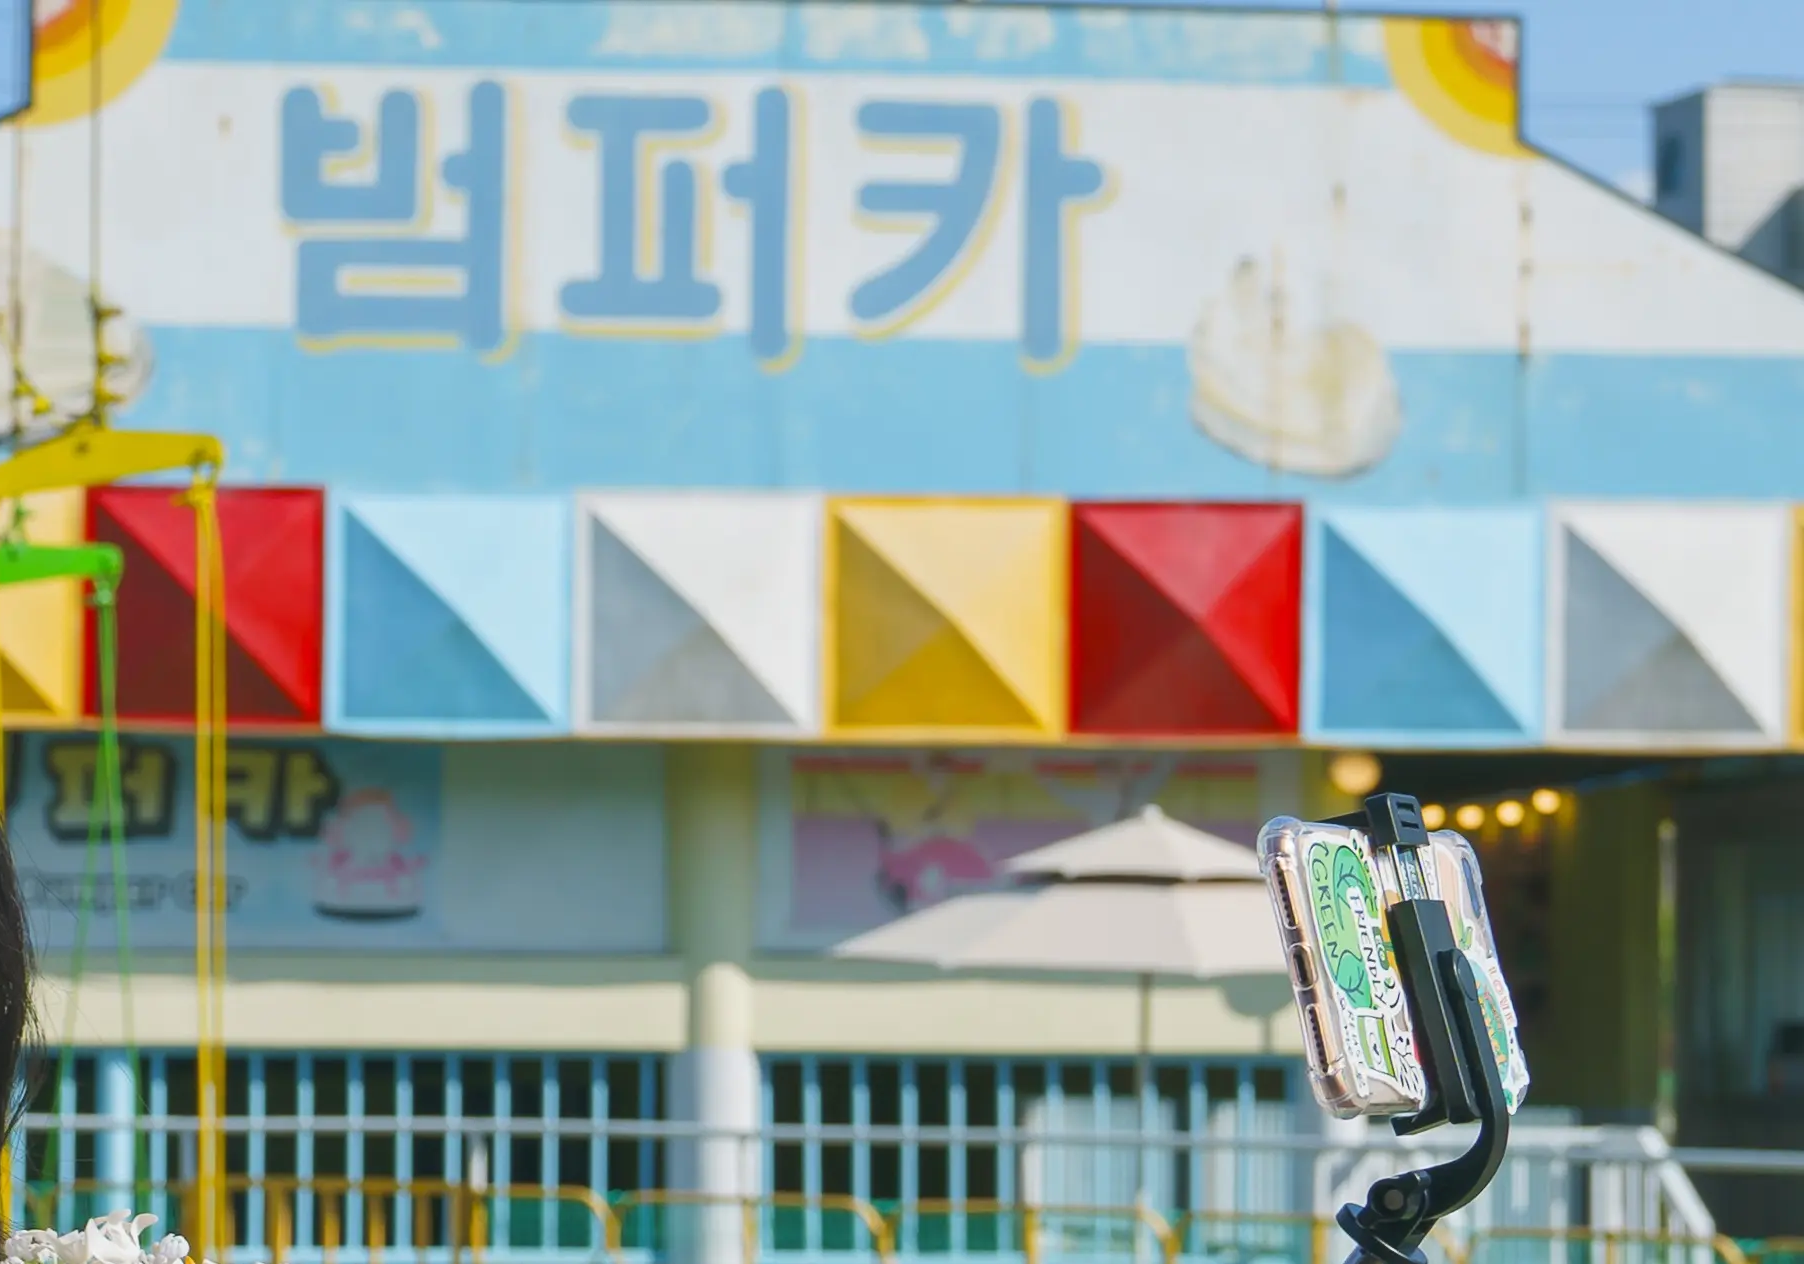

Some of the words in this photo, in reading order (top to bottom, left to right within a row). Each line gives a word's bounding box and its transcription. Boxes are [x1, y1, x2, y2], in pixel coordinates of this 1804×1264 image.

[281, 80, 1116, 371] 범퍼카
[10, 738, 338, 842] 퍼카
[1312, 859, 1339, 958] GREEN
[1350, 896, 1387, 1005] FRIENDLY
